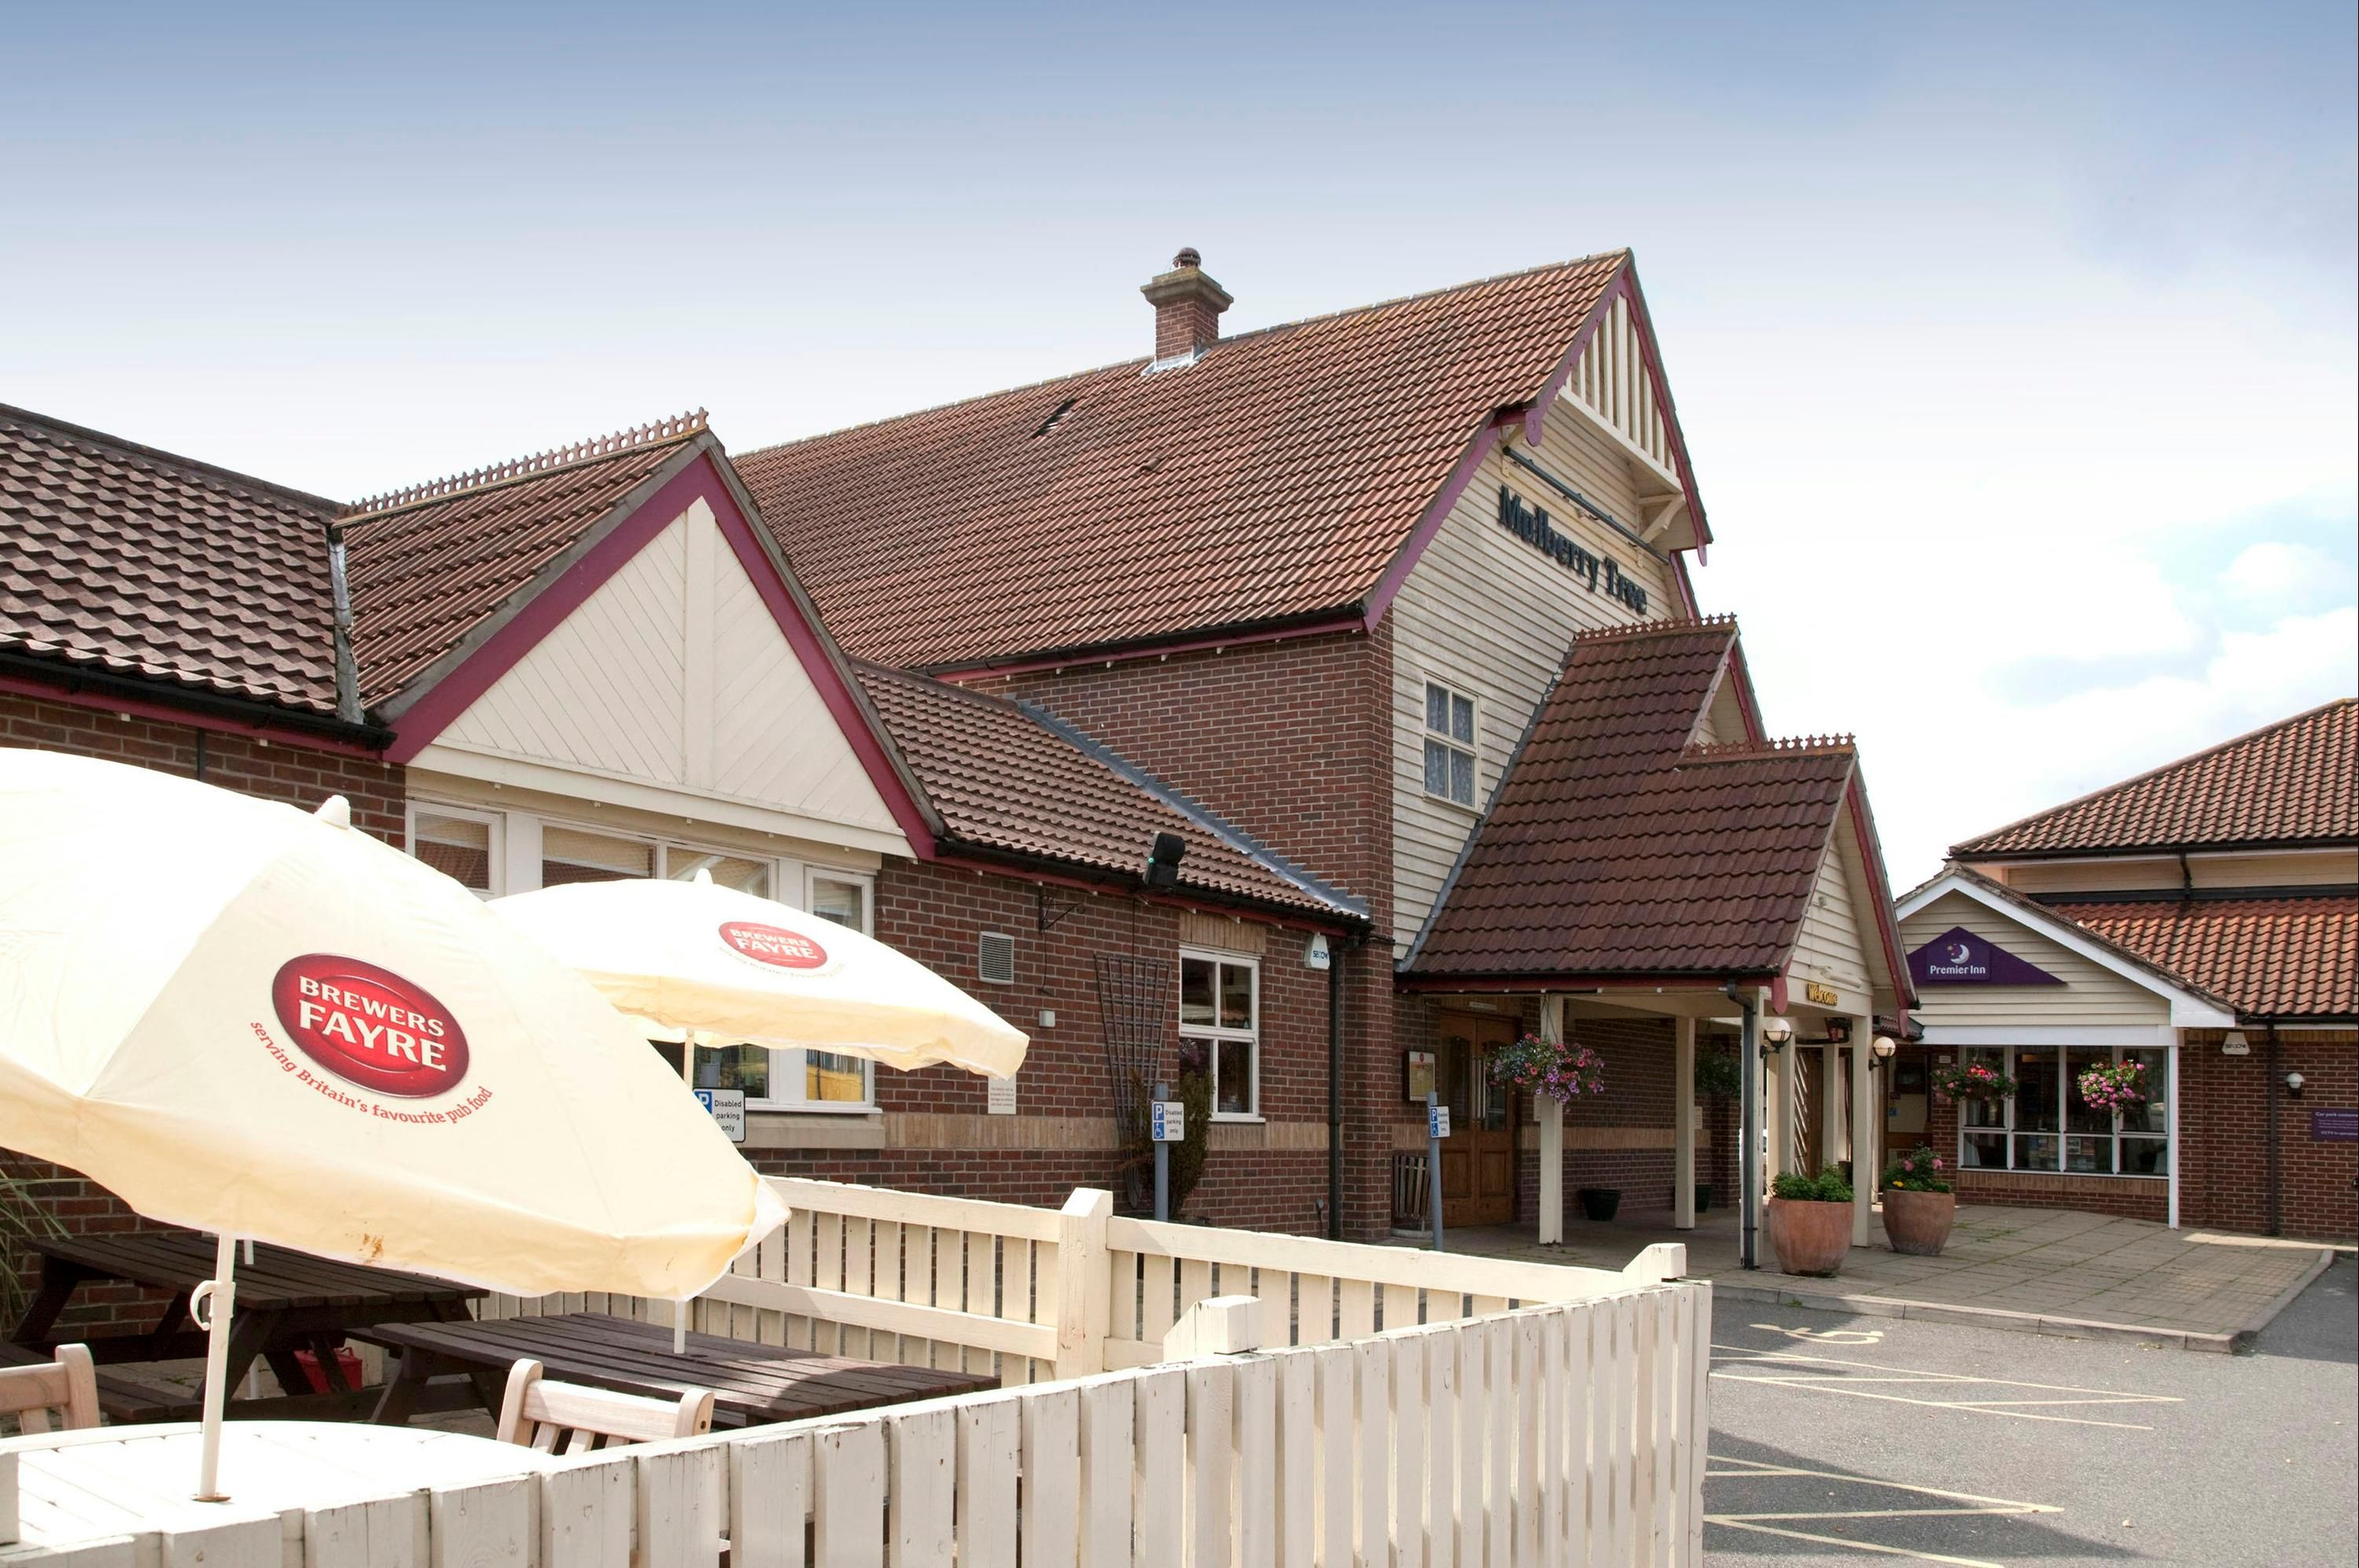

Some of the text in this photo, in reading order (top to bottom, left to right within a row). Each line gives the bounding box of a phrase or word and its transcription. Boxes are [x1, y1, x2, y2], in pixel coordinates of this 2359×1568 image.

[1499, 484, 1648, 615] Mulberry Tree
[729, 928, 811, 948] BREWERS
[734, 937, 819, 959] FAYRE
[1930, 965, 1986, 974] Premier Inn
[299, 975, 446, 1037] BREWERS
[1807, 982, 1838, 1007] Welcome
[299, 999, 447, 1072] FAYRE
[250, 1021, 493, 1124] serving Britain's favourite pub food
[716, 1112, 740, 1121] parking
[1155, 1105, 1163, 1120] P
